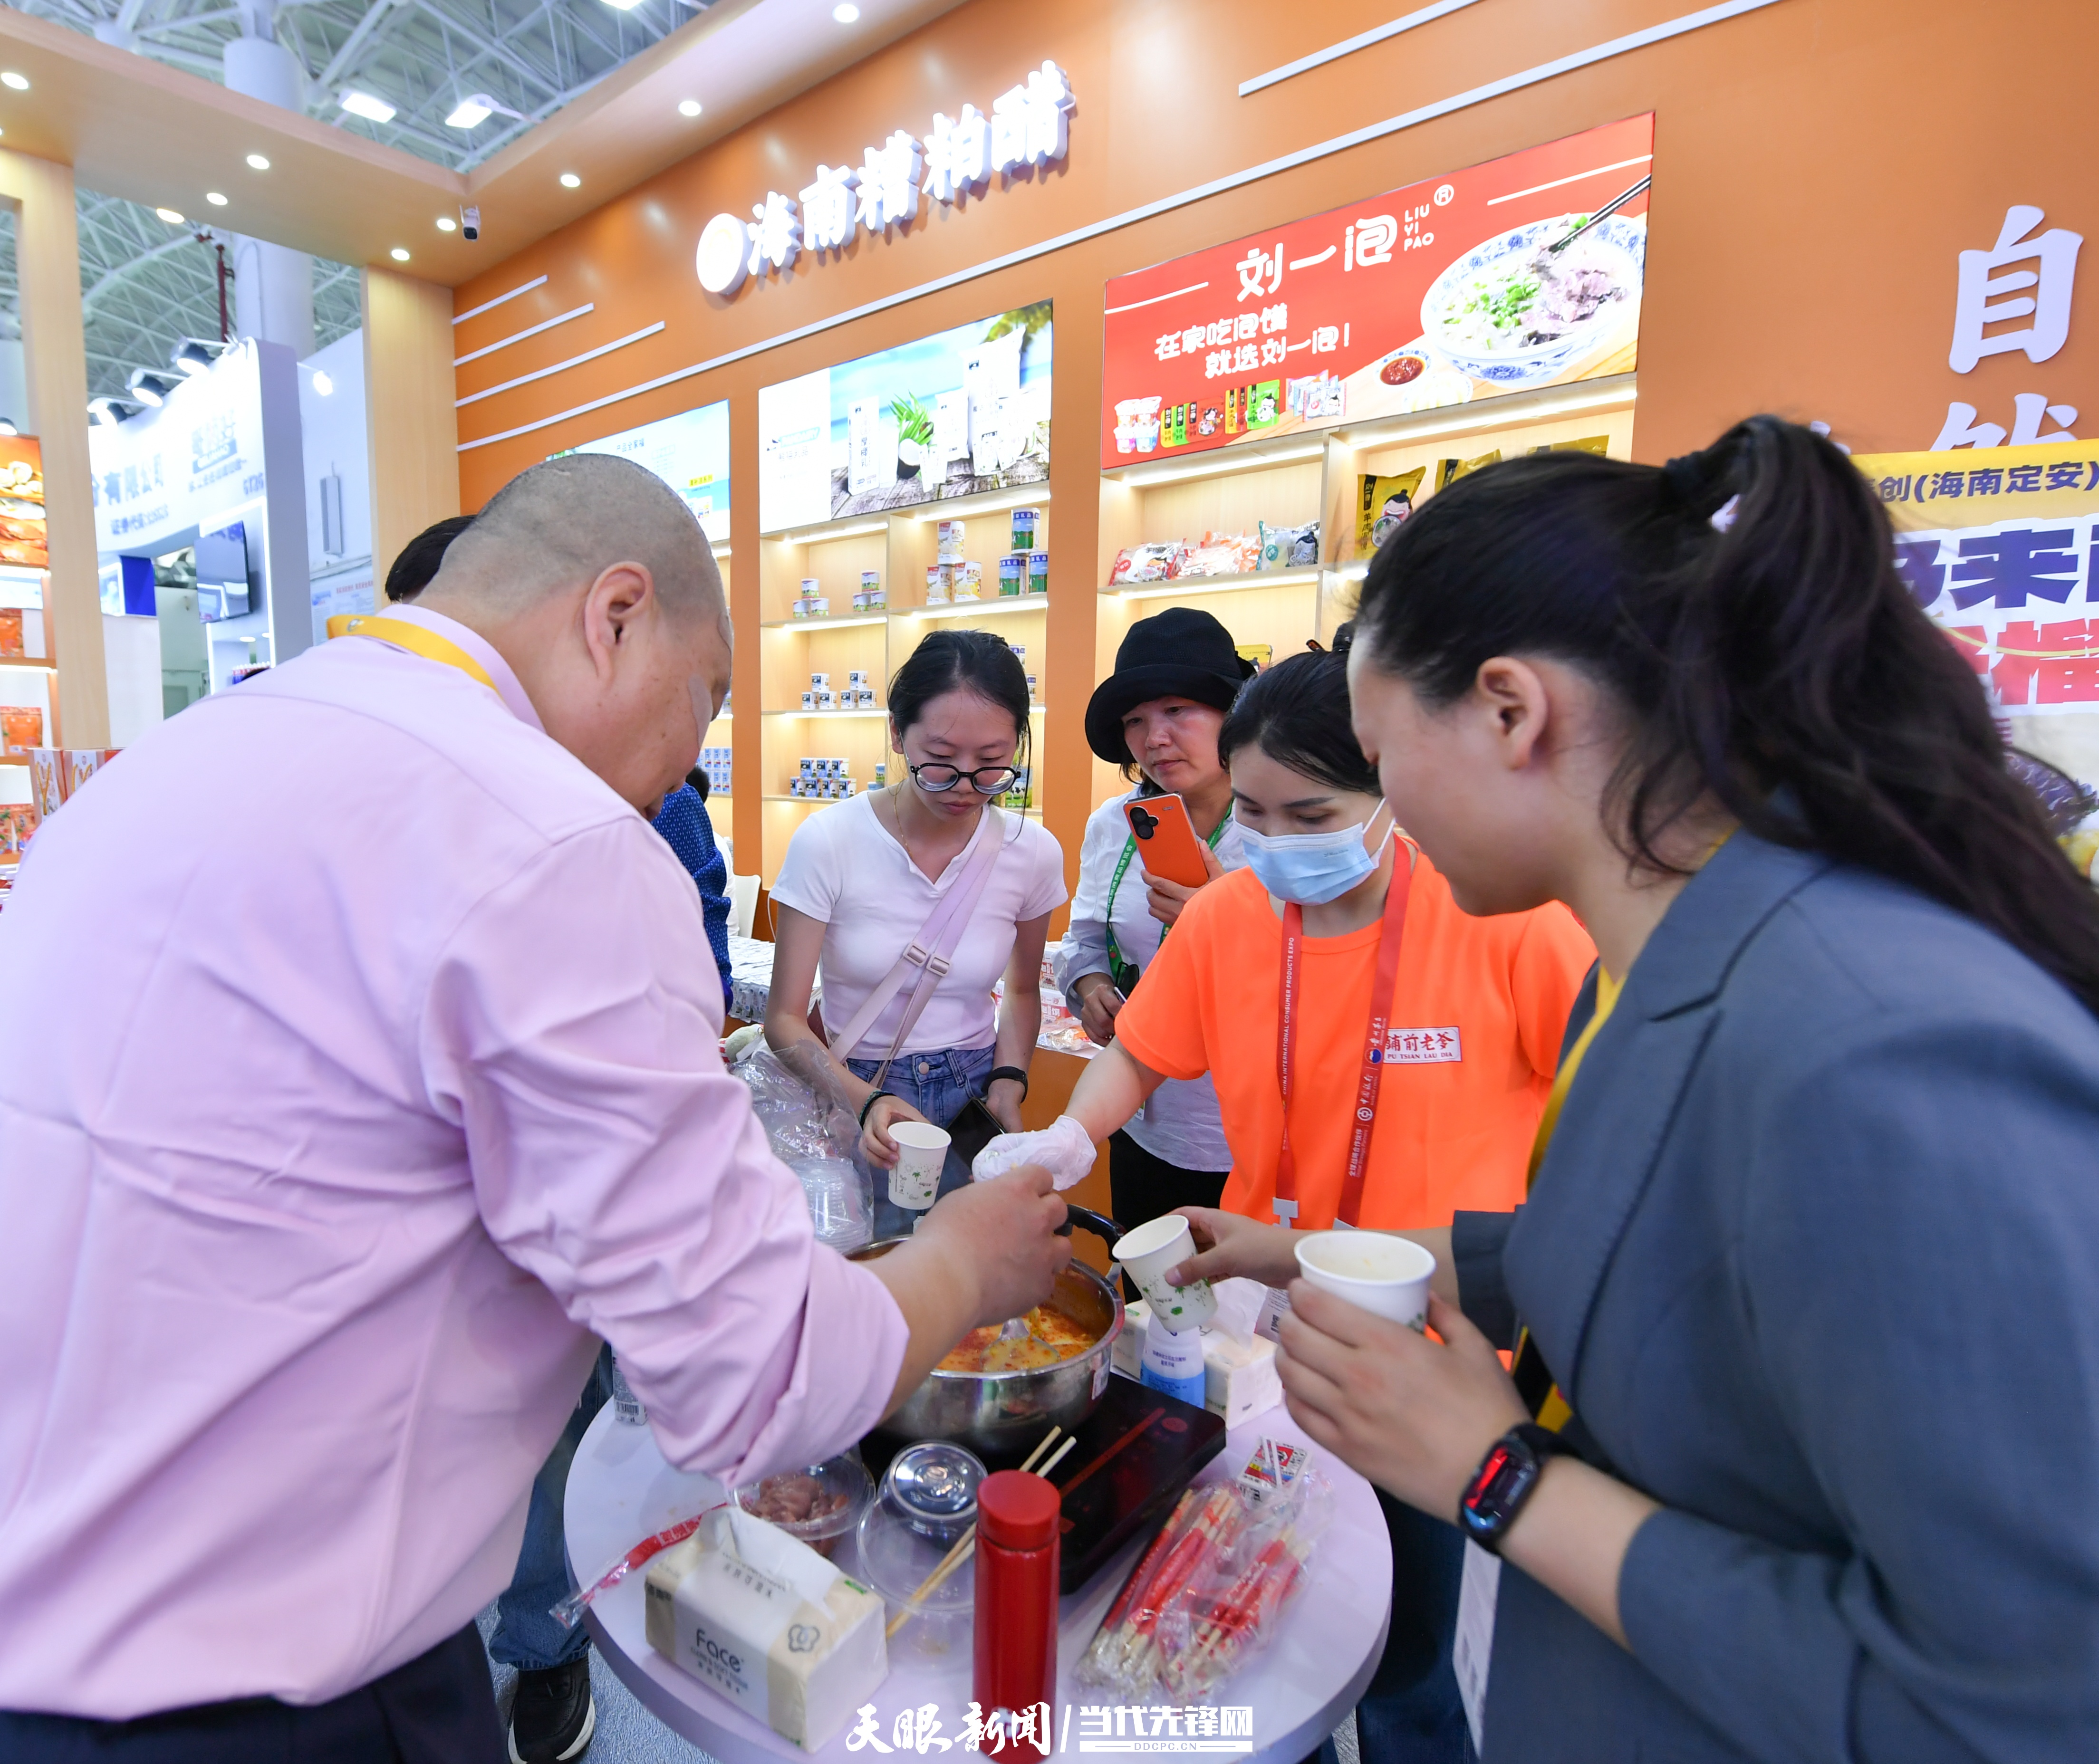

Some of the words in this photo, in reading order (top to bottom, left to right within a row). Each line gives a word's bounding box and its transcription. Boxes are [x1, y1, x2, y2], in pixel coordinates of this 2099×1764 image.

[1404, 221, 1419, 237] YI
[1405, 203, 1430, 223] LIU
[1236, 214, 1397, 303] 刘一泡
[1404, 232, 1435, 252] PAO
[1155, 302, 1287, 361] 在家吃泡馍
[1870, 461, 2099, 503] 创(海南定安)
[696, 1628, 741, 1673] Face
